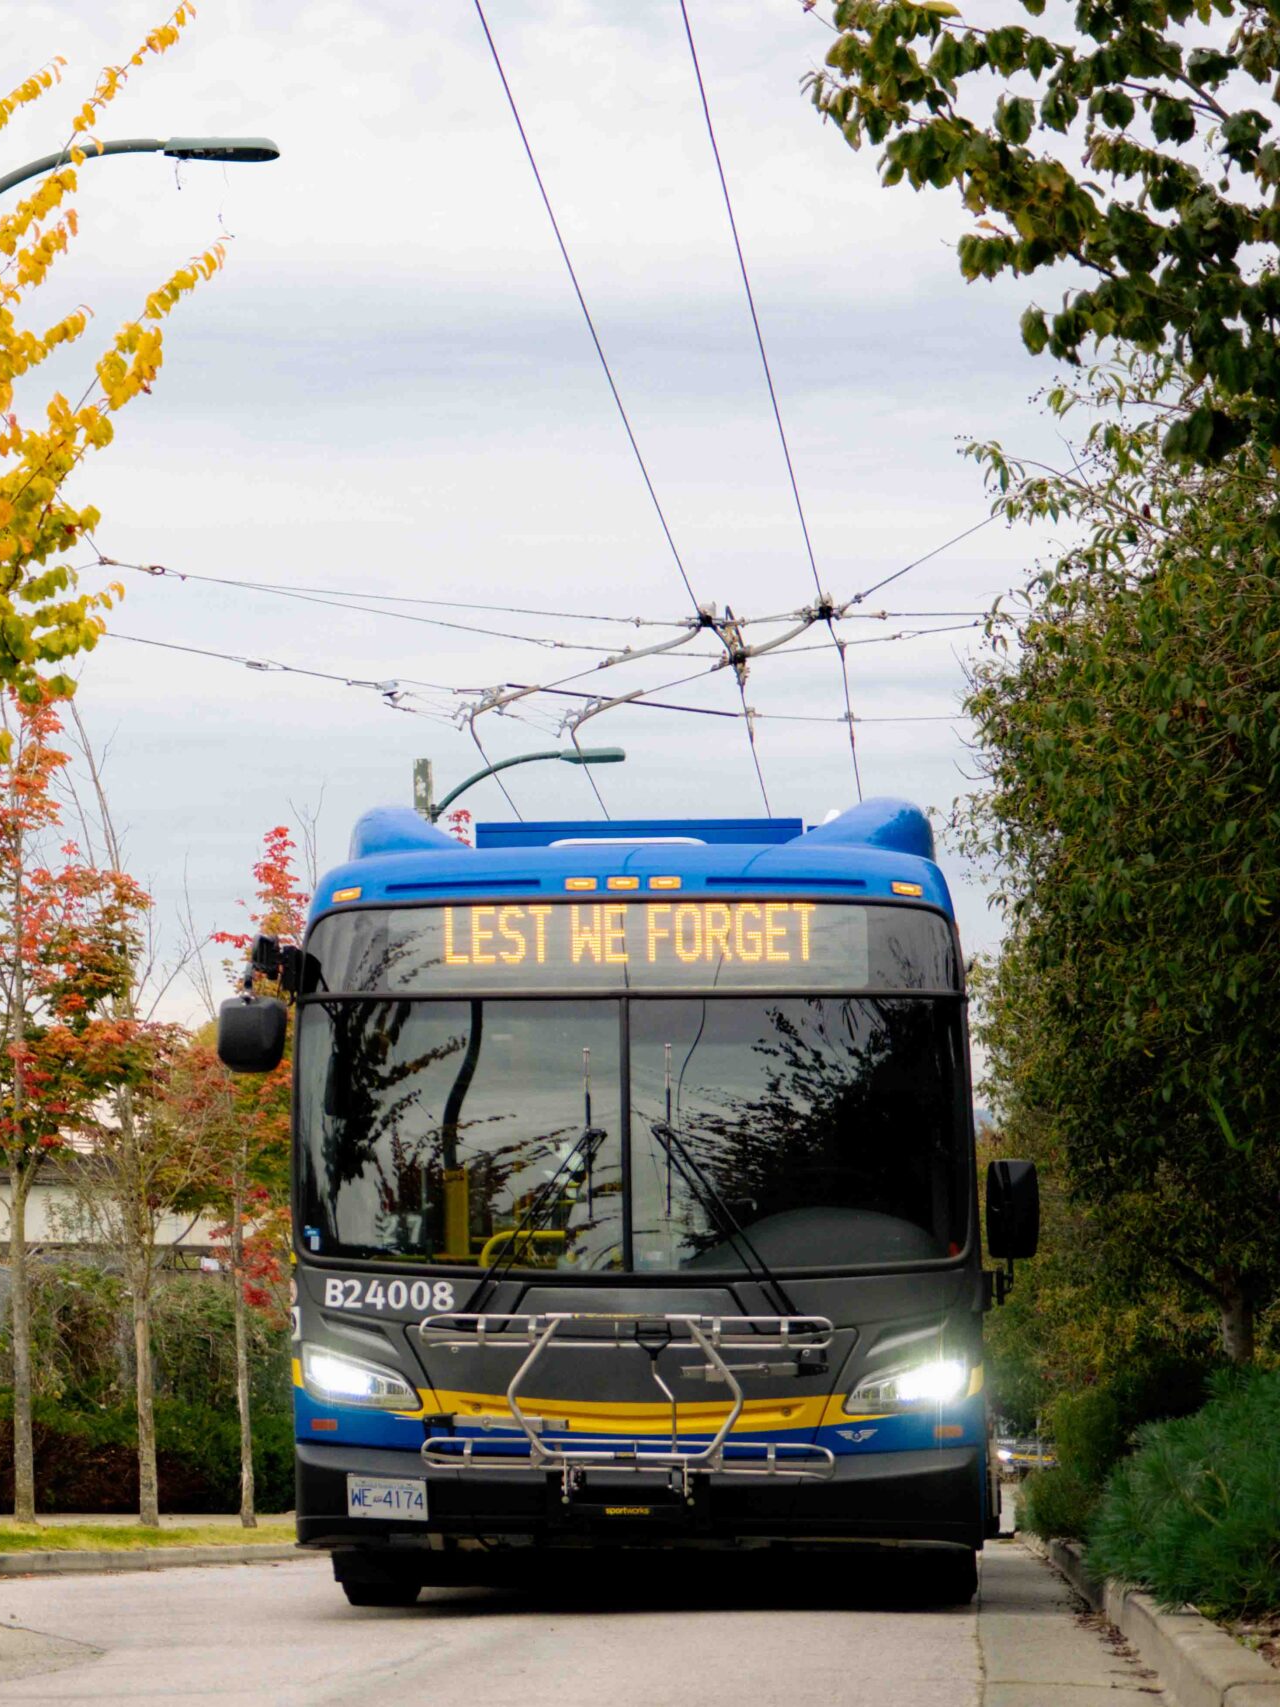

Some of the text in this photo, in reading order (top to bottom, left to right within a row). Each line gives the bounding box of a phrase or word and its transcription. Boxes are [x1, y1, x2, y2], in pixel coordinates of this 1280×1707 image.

[444, 903, 816, 963] LEST WE FORGET
[324, 1278, 455, 1312] B24008
[605, 1506, 650, 1515] sportworks
